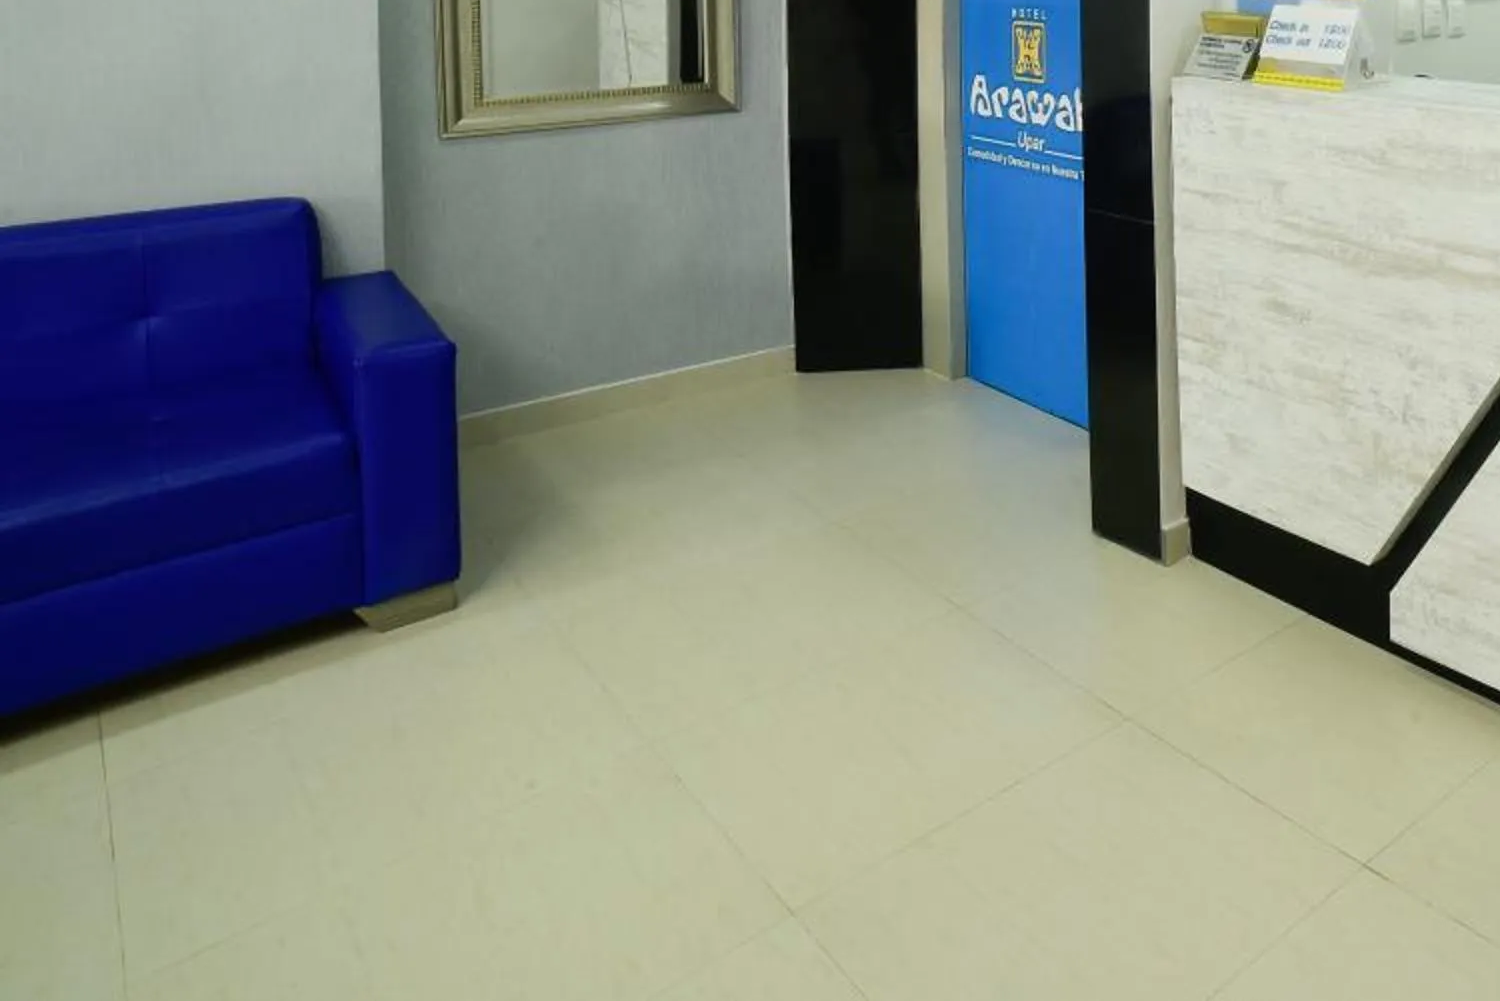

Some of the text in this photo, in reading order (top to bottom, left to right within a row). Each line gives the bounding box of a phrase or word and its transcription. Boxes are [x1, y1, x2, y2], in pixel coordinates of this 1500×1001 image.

[1011, 7, 1048, 20] HOTEL
[1266, 35, 1293, 45] Check
[1017, 131, 1045, 152] Upar
